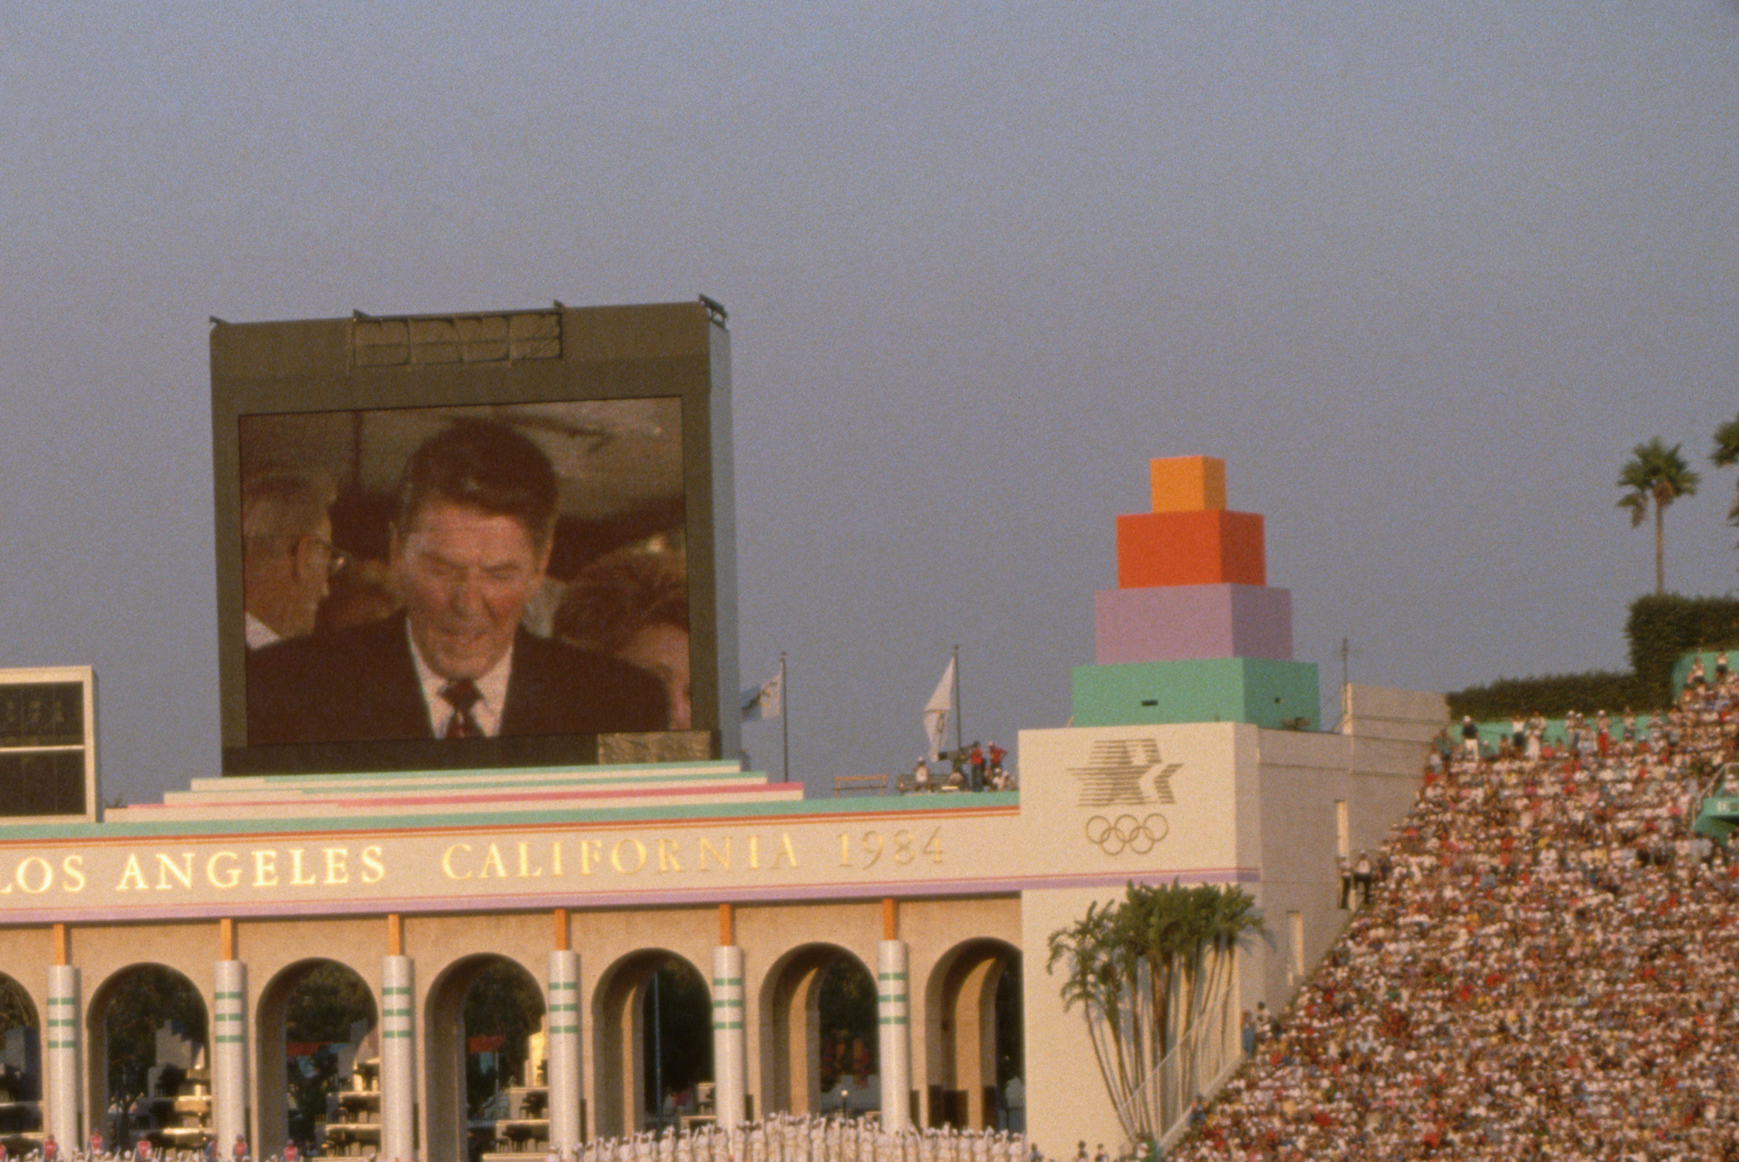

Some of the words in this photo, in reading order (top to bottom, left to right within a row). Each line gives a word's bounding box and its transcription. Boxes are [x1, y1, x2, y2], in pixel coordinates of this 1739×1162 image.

[116, 845, 387, 891] ANGELES
[441, 832, 800, 881] CALIFORNIA
[836, 826, 943, 870] 1984
